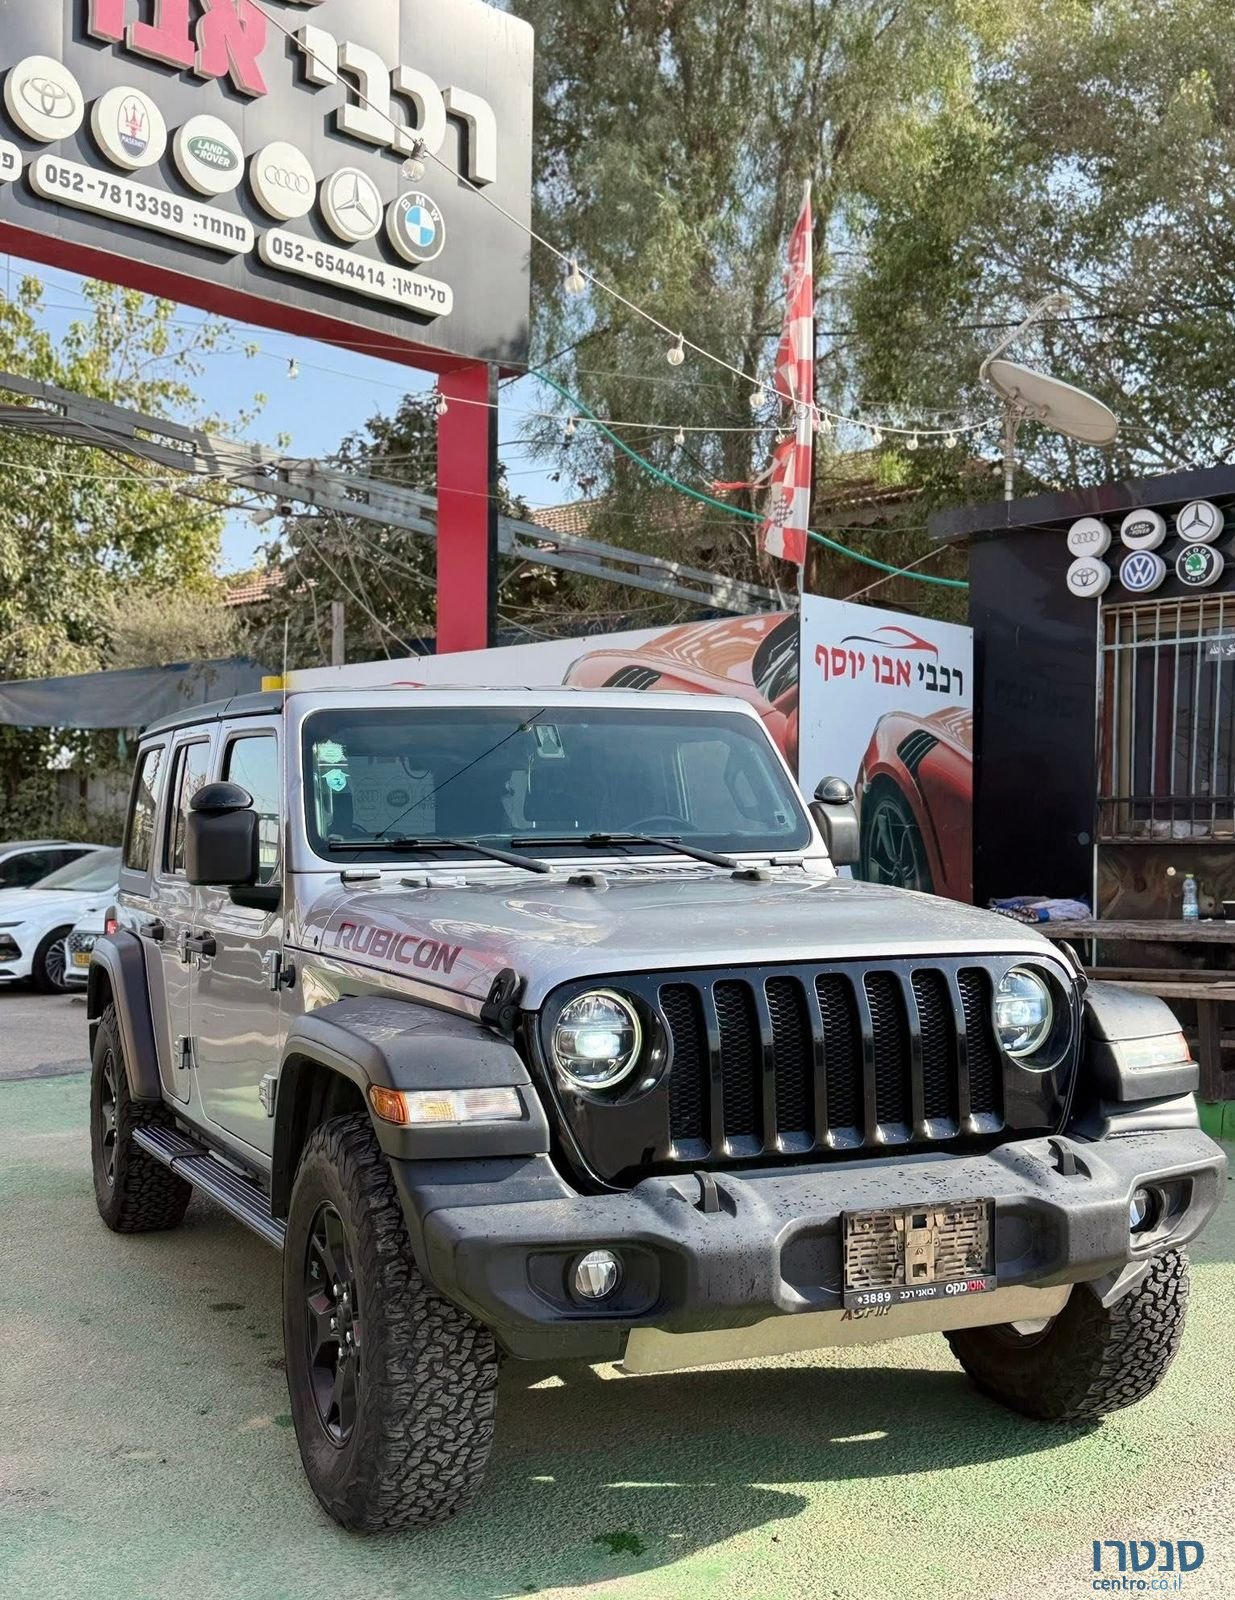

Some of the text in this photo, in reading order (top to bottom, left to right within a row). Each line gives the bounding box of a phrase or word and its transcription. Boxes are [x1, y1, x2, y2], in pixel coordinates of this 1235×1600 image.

[297, 24, 497, 184] רכבי
[45, 163, 184, 224] 052-7813399
[400, 195, 440, 222] BMW
[272, 237, 386, 287] 052-6544414
[815, 644, 963, 696] רכבי אבו יוסף
[334, 921, 463, 975] RUBICON
